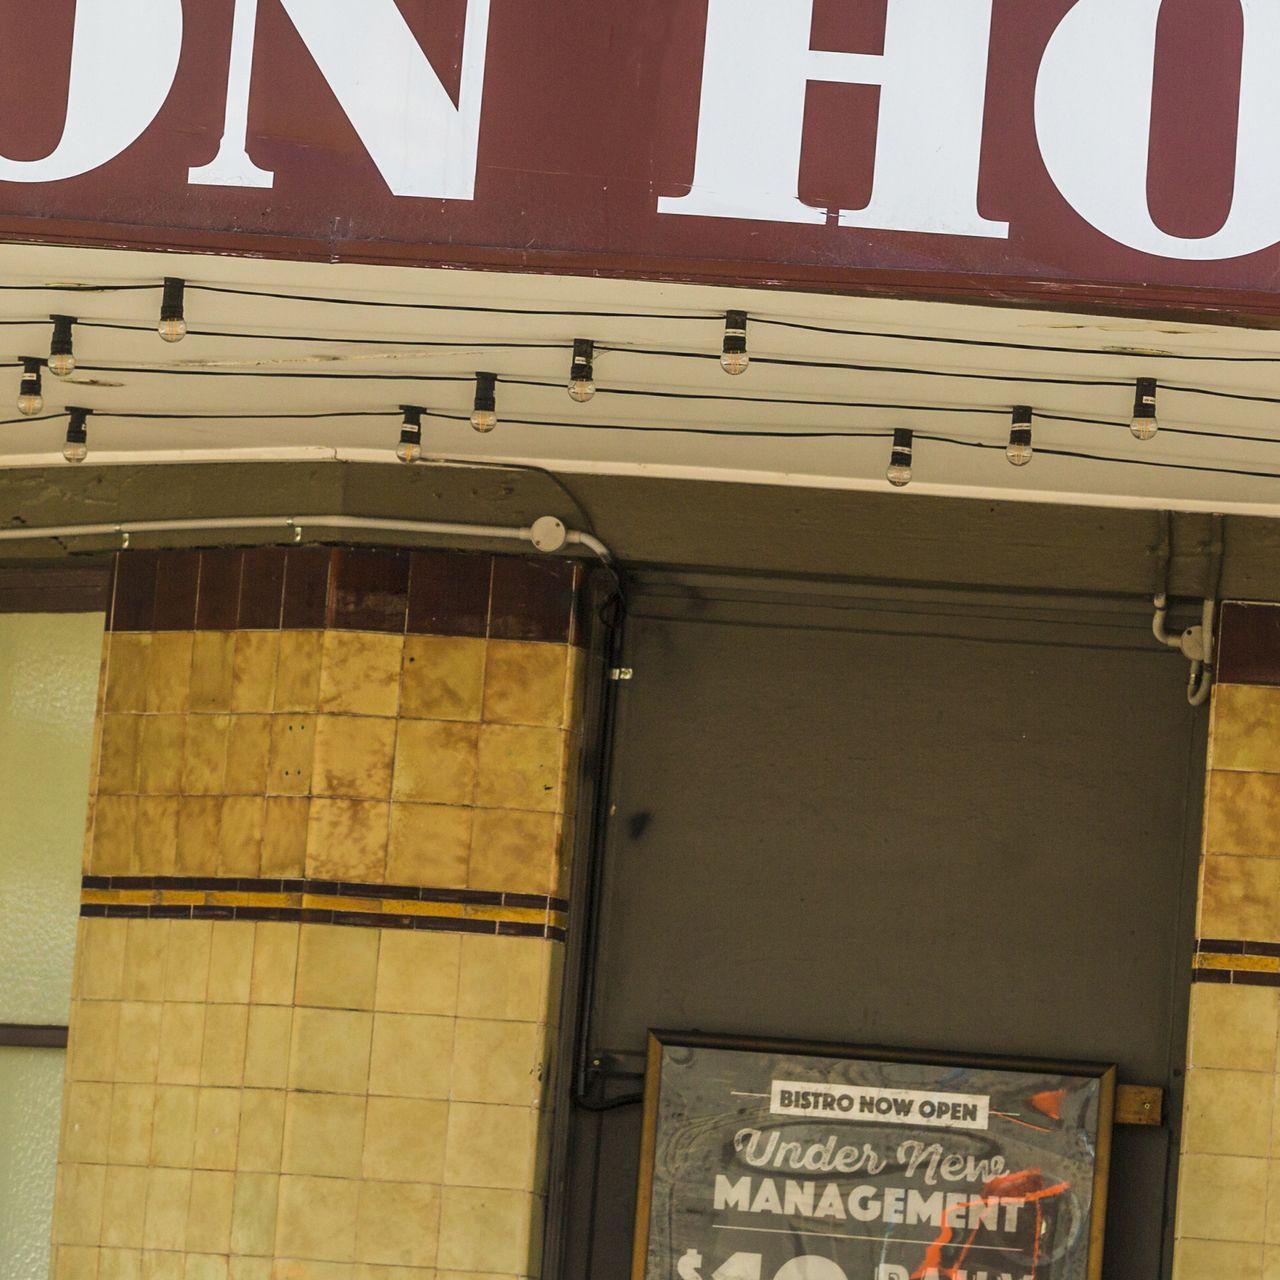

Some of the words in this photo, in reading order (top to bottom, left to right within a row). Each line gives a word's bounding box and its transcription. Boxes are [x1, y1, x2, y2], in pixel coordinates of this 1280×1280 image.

[780, 1090, 854, 1112] BISTRO
[859, 1095, 914, 1116] NOW
[919, 1100, 978, 1122] OPEN
[734, 1128, 886, 1175] Under
[897, 1140, 1010, 1186] New
[713, 1175, 1025, 1233] MANAGEMENT
